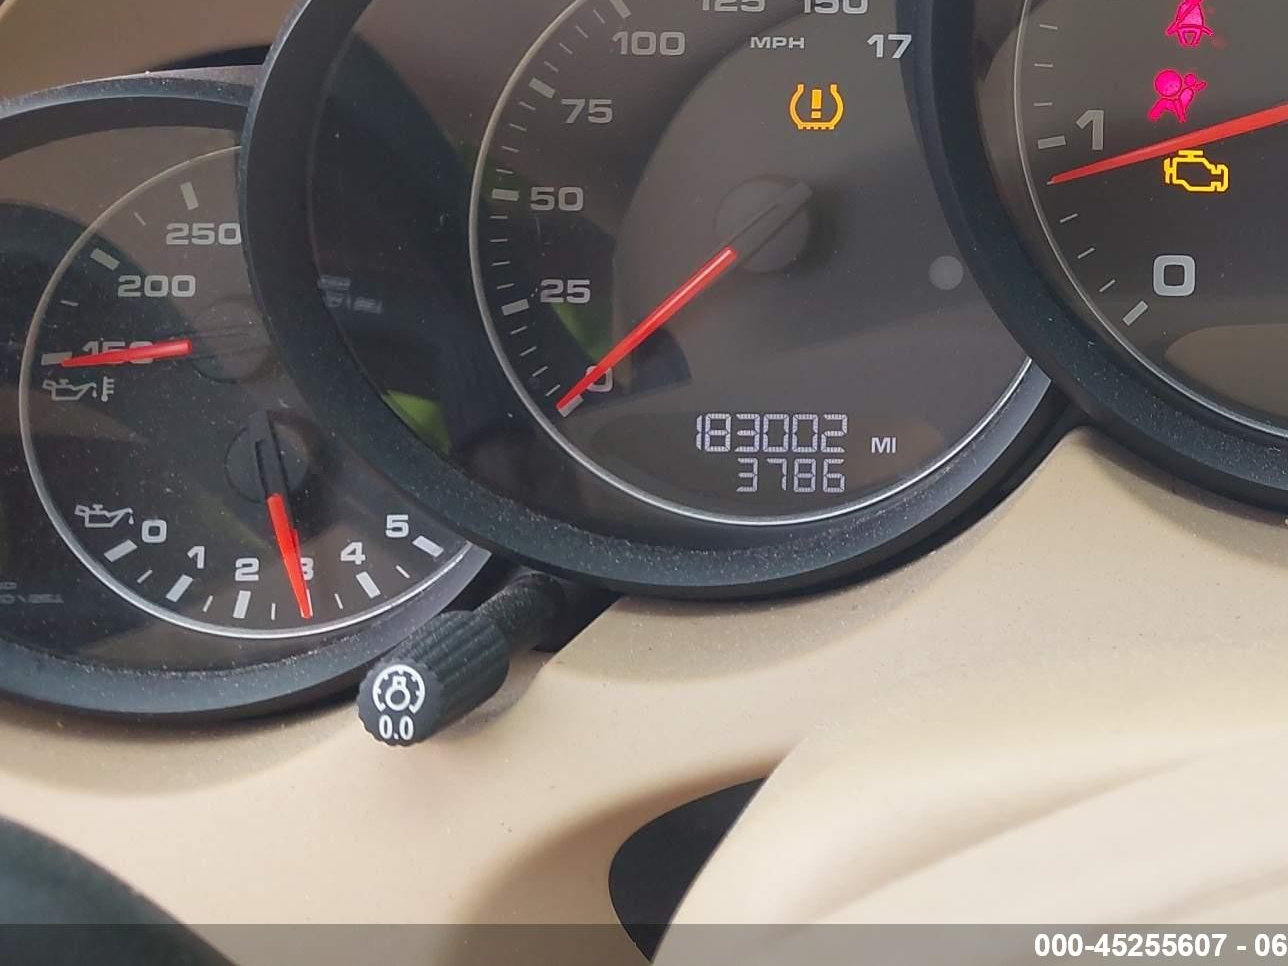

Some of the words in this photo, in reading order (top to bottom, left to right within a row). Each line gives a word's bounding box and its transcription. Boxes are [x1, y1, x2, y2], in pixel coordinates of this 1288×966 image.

[612, 31, 686, 56] 100
[750, 36, 806, 50] MPH
[866, 34, 912, 59] 17
[561, 99, 614, 124] 75
[1075, 109, 1105, 151] 1
[530, 187, 584, 211] 50
[166, 223, 242, 245] 250
[118, 275, 196, 297] 200
[1153, 255, 1196, 297] 0
[540, 279, 591, 303] 25
[696, 414, 848, 453] 183002
[871, 437, 897, 453] MI
[736, 458, 845, 493] 3786
[142, 520, 167, 543] 0
[386, 514, 409, 538] 5
[187, 546, 205, 568] 1
[341, 542, 365, 565] 4
[235, 558, 259, 581] 2
[379, 716, 414, 741] 0.0
